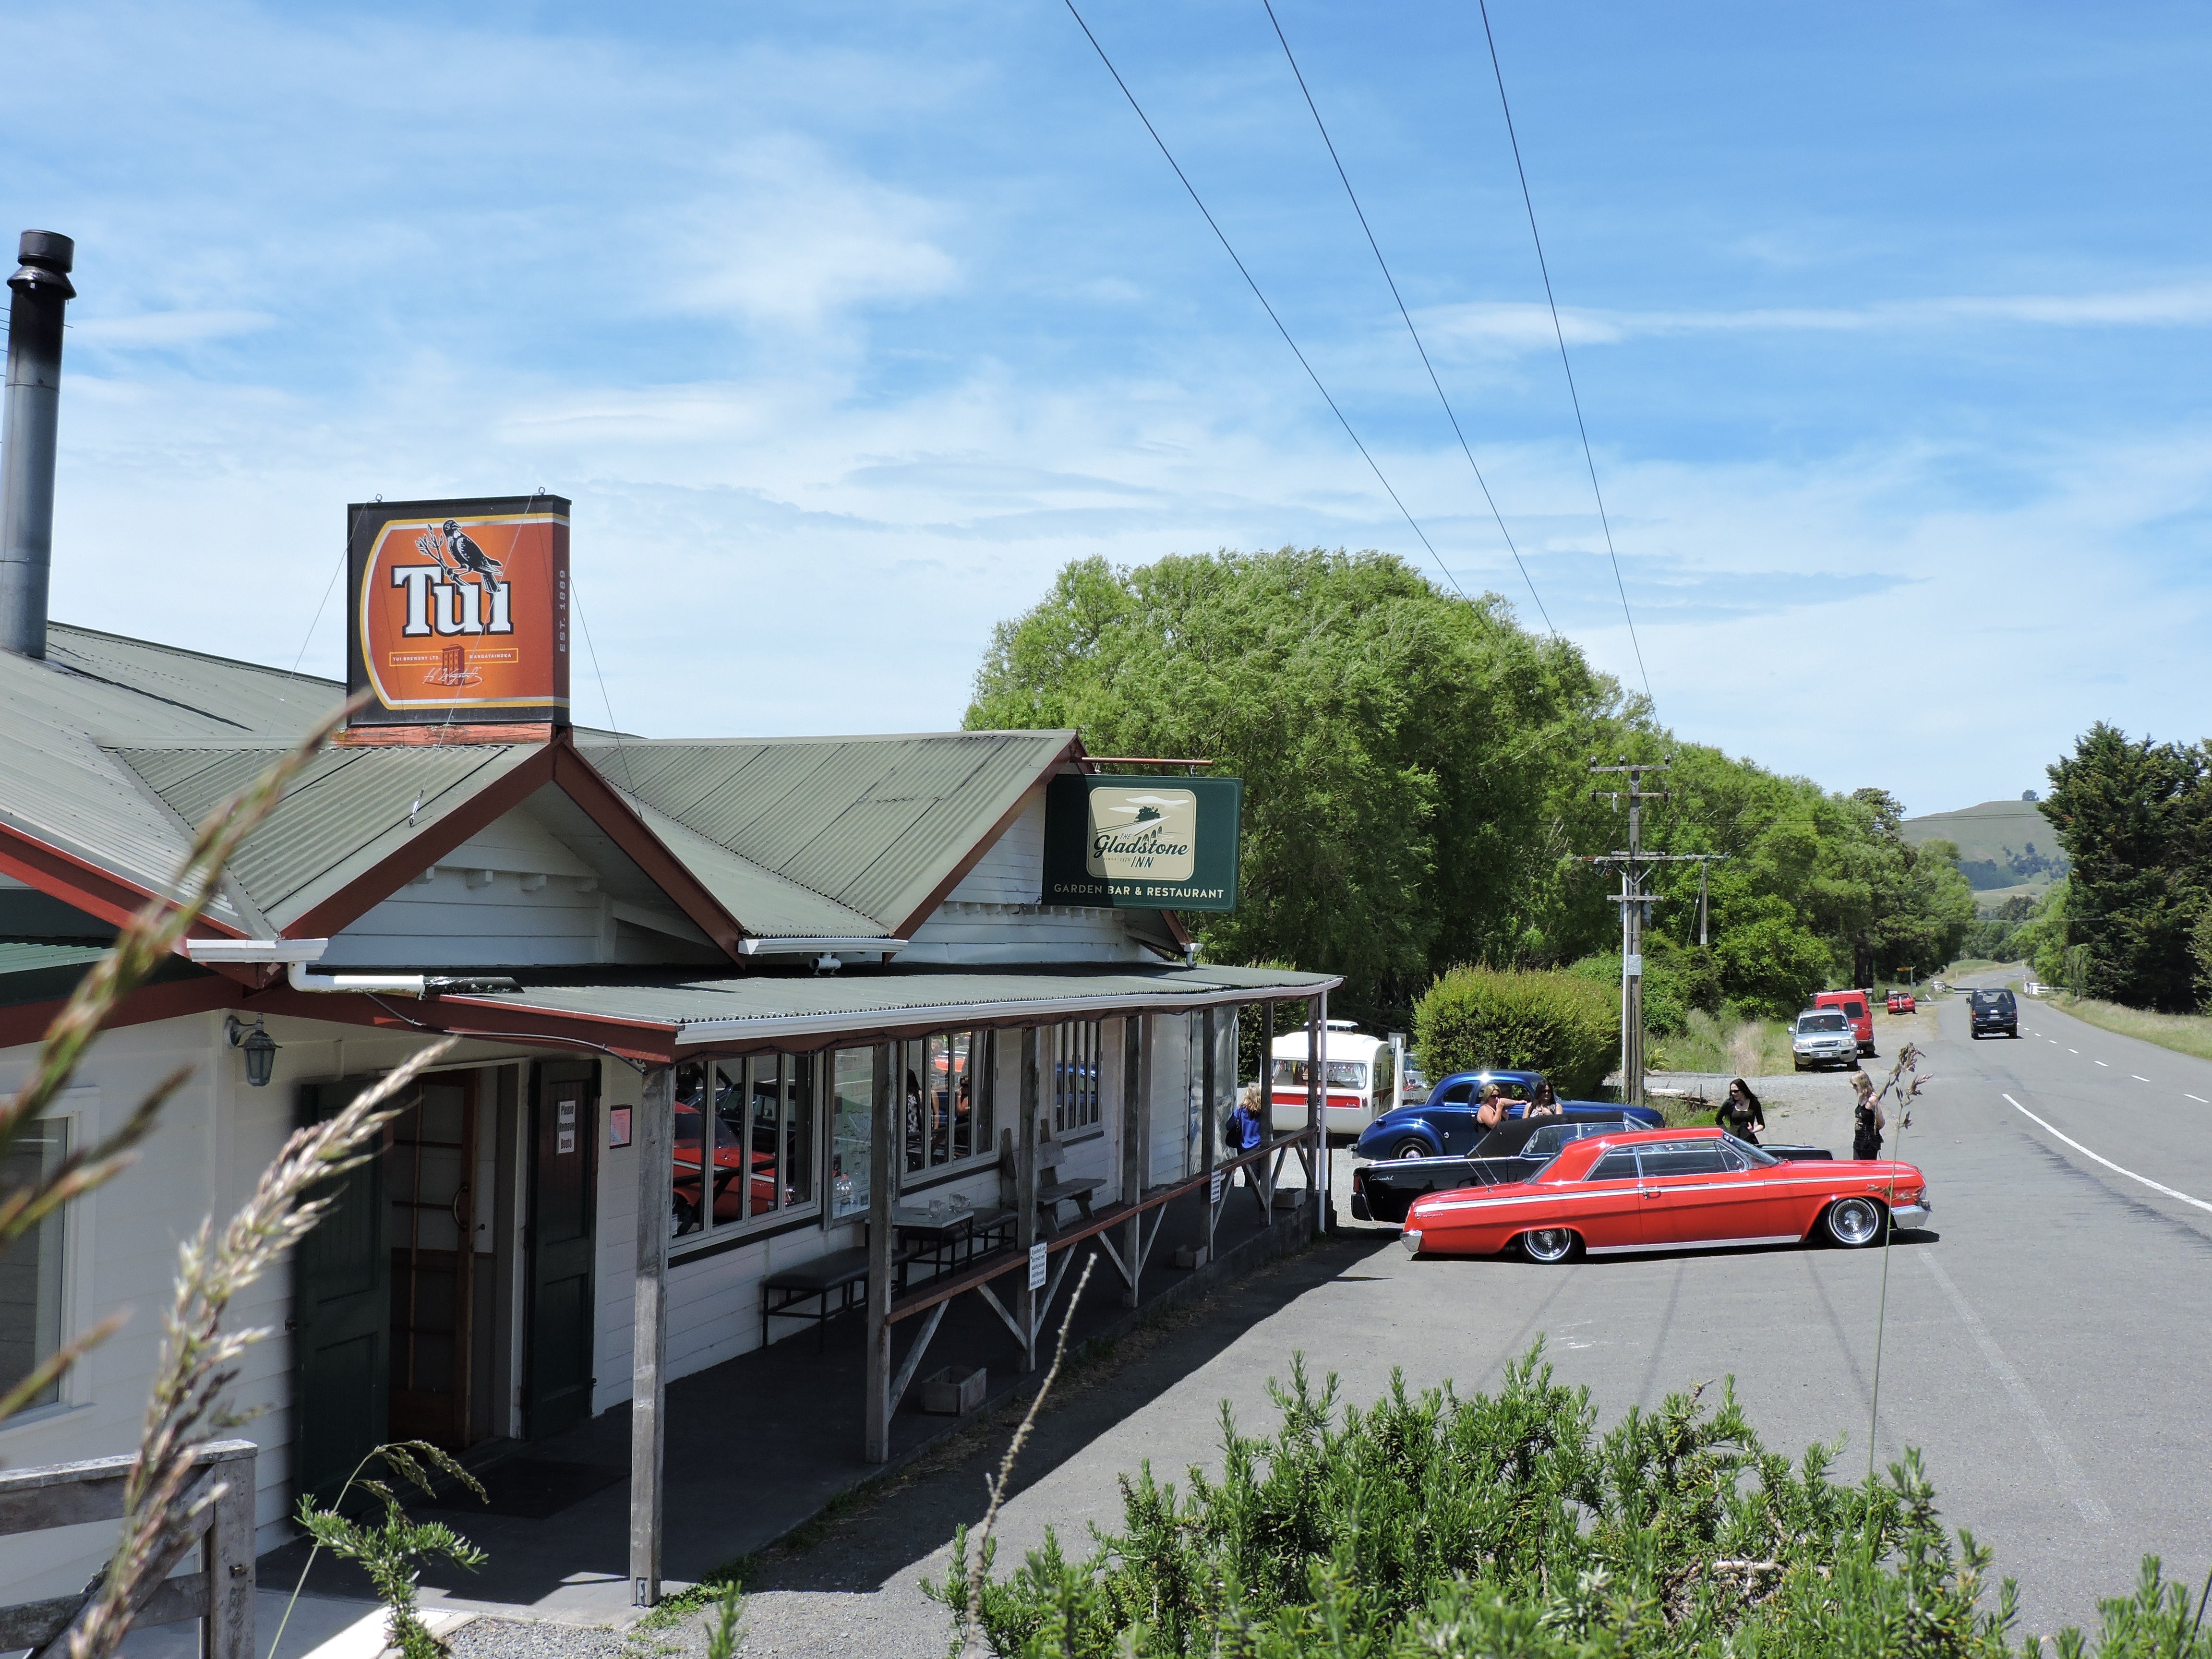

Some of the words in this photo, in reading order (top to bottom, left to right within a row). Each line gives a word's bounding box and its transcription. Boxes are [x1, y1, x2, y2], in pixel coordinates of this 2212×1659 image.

[391, 564, 514, 638] Tui
[1094, 834, 1190, 858] Gladstone
[1130, 855, 1154, 868] INN
[1054, 883, 1102, 894] GARDEN
[1107, 885, 1130, 895] BAR
[1135, 886, 1142, 896] &
[1147, 887, 1224, 899] RESTAURANT
